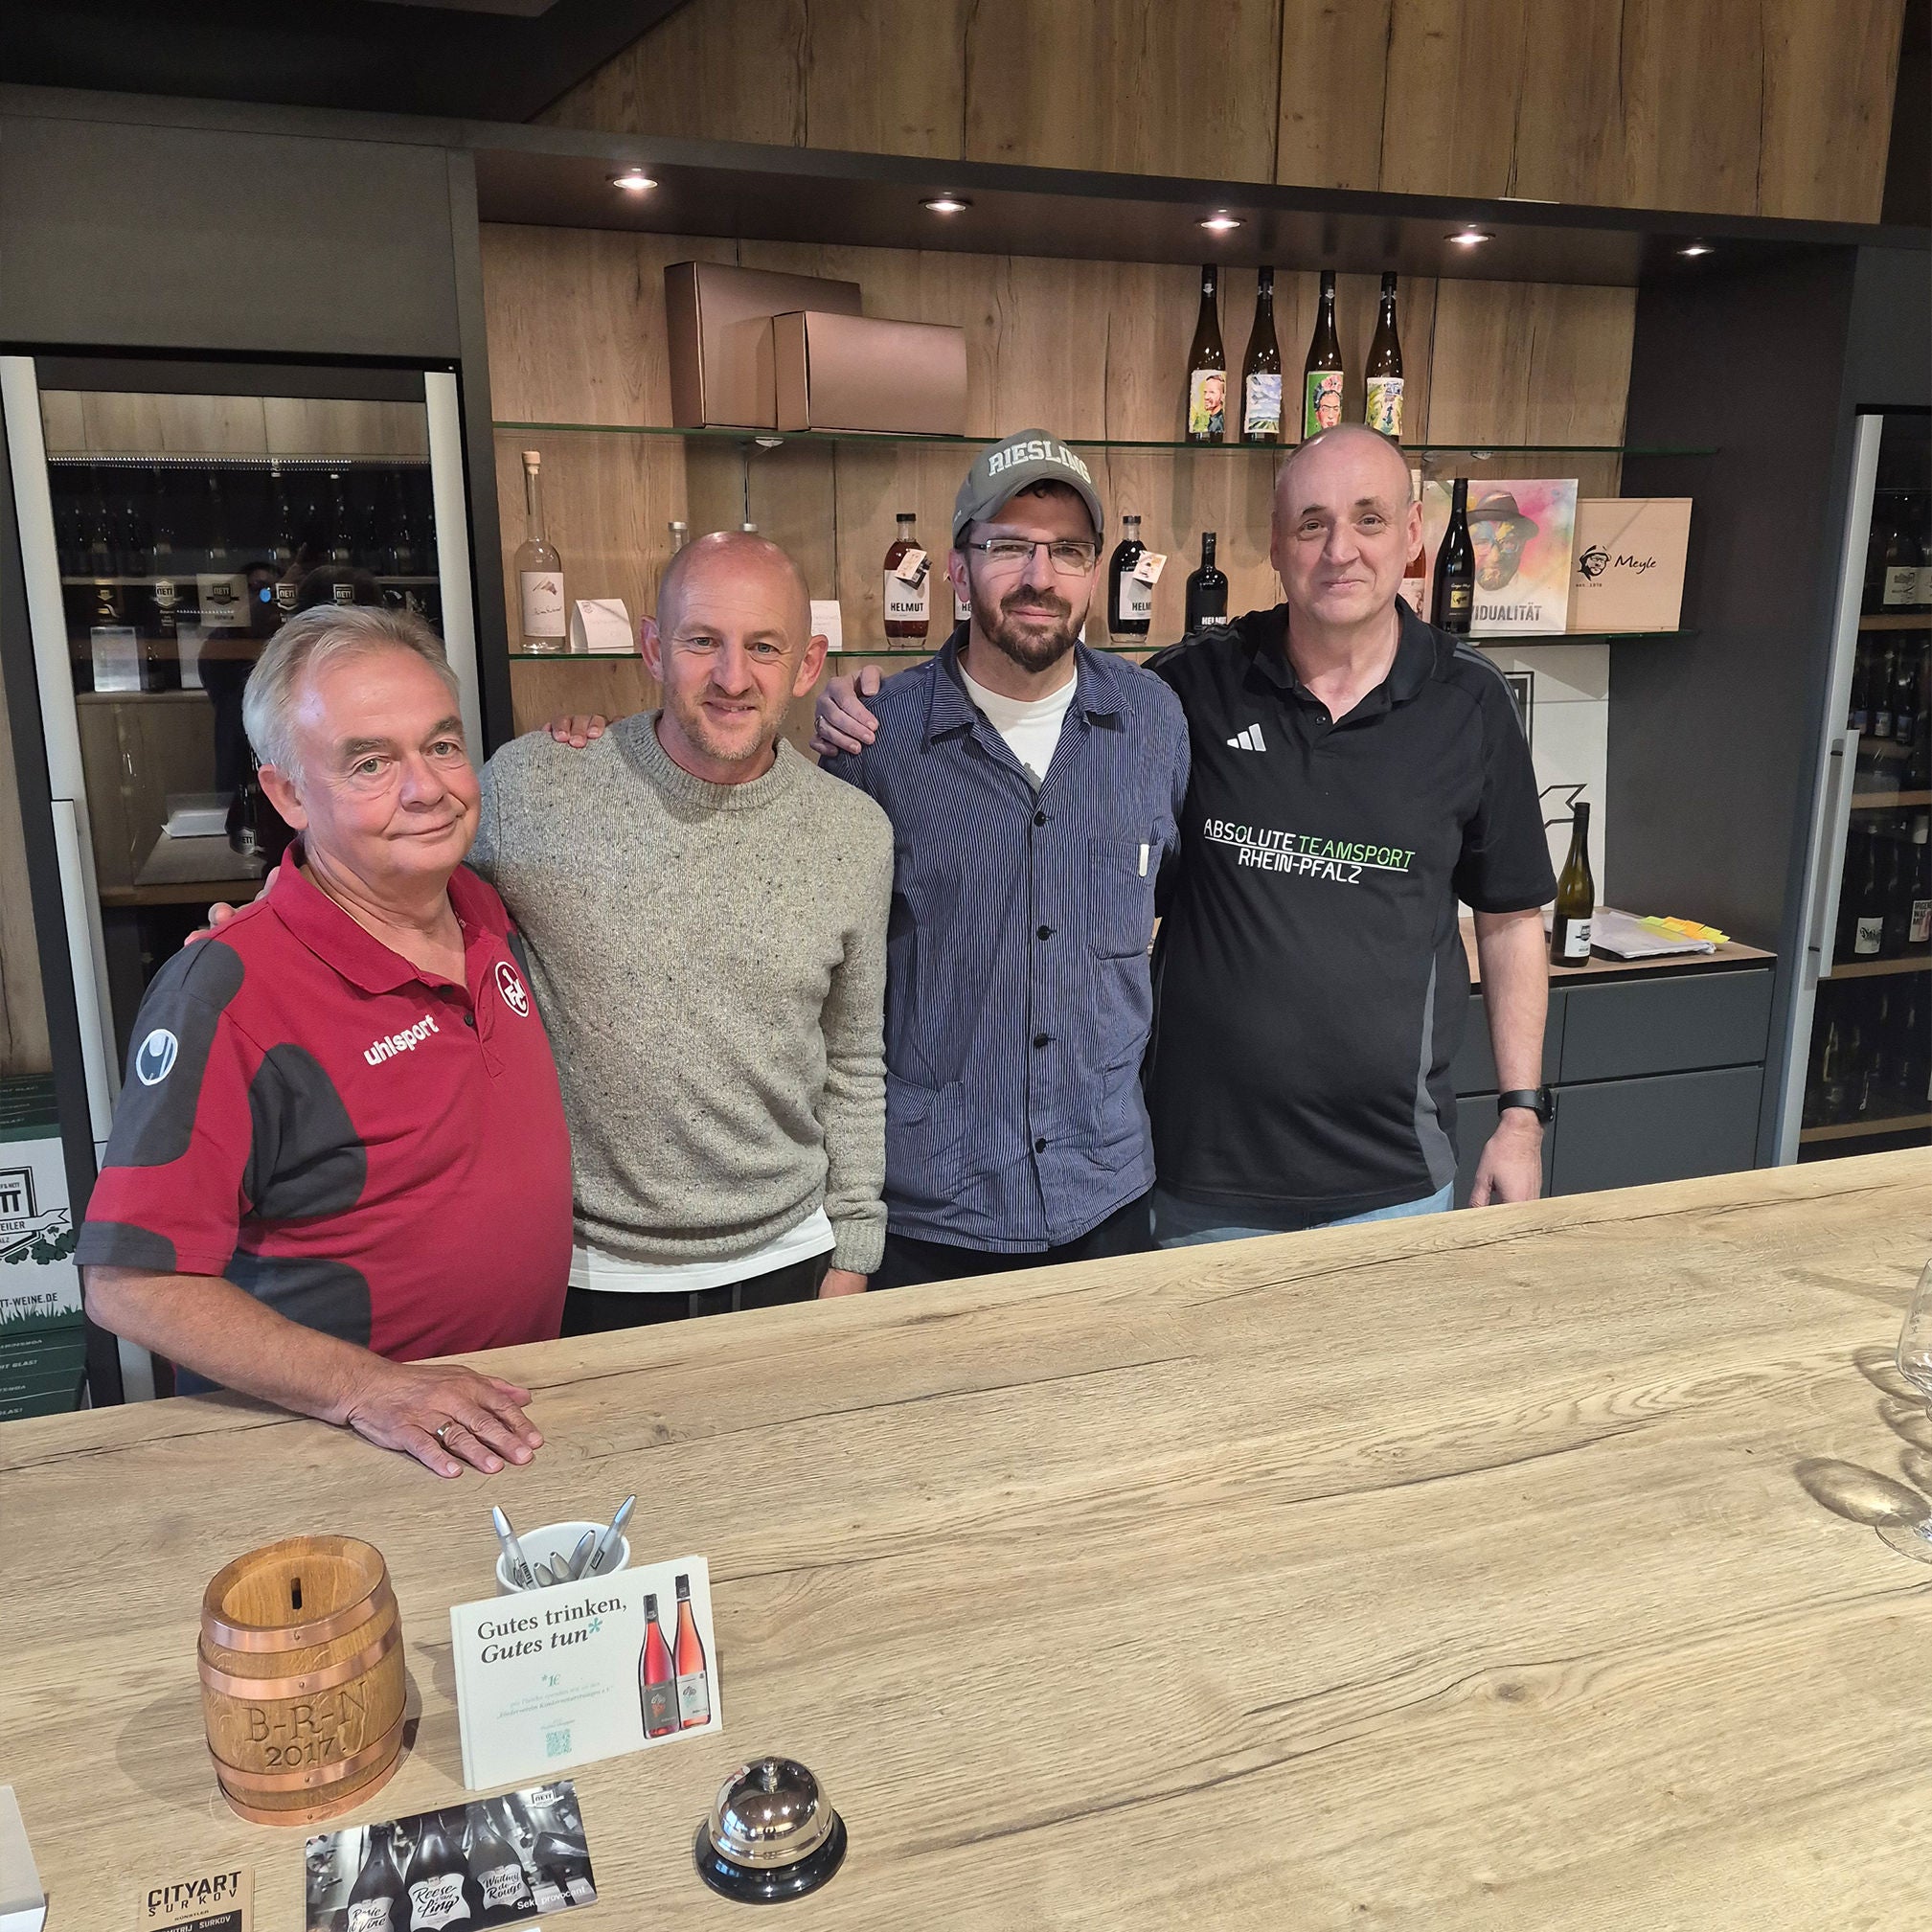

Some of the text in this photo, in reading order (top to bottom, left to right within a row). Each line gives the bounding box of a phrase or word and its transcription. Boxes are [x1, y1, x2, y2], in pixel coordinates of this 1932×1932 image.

[988, 440, 1092, 485] RIESLING
[1614, 555, 1657, 575] Meyle
[890, 602, 924, 612] HELMUT
[1203, 818, 1416, 869] ABSOLUTE TEAMSPORT
[1238, 847, 1363, 884] RHEIN-PFALZ
[363, 1014, 440, 1066] uhlsport
[477, 1598, 627, 1640] Gutes trinken,
[481, 1639, 543, 1664] Gutes
[264, 1737, 336, 1767] 2017
[148, 1871, 242, 1908] CITYART
[412, 1885, 457, 1904] Reese
[487, 1882, 522, 1899] Rouge
[517, 1898, 536, 1910] Sek
[199, 1916, 232, 1929] SURKOV
